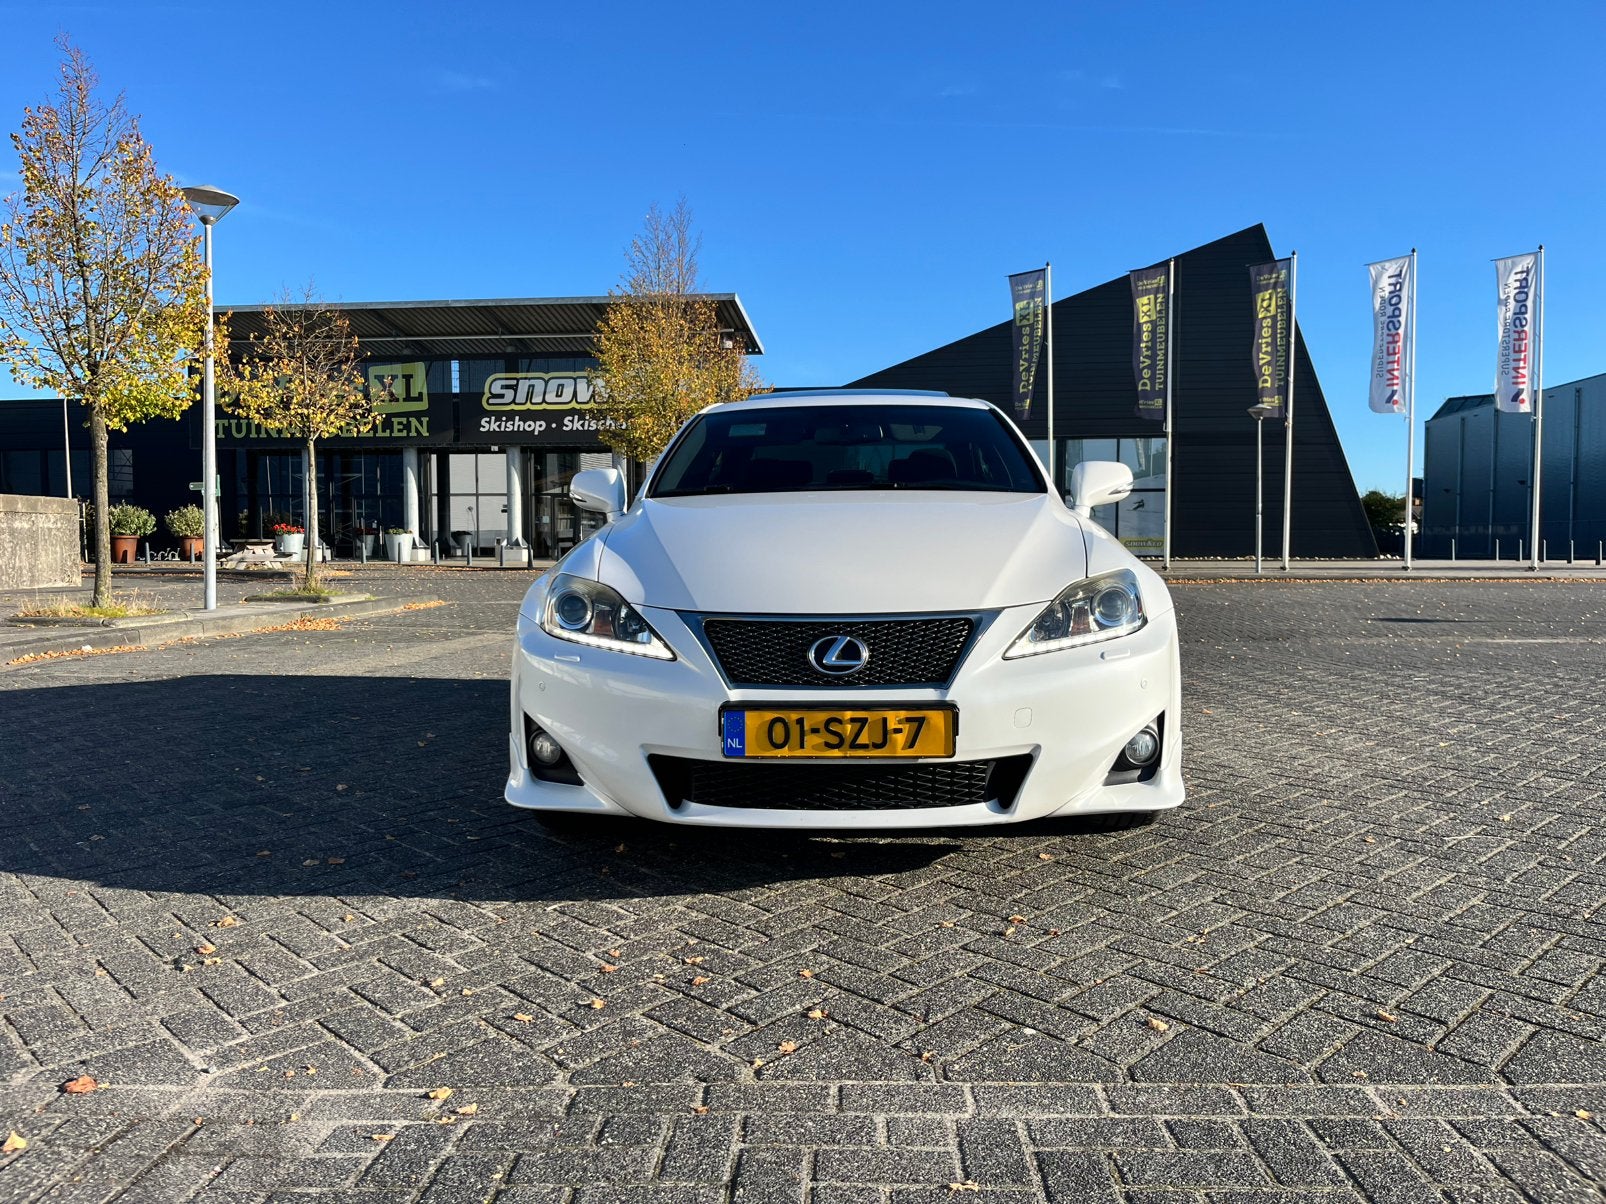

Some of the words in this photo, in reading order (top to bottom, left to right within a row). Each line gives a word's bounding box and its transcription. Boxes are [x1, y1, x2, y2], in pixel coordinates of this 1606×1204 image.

[1155, 294, 1166, 391] TUINMEUBELEN
[1275, 288, 1286, 388] TUINMEUBELEN
[216, 416, 430, 438] TUINBELEN
[479, 415, 547, 435] Skishop
[727, 738, 743, 749] NL
[767, 716, 926, 750] 01-SZJ-7
